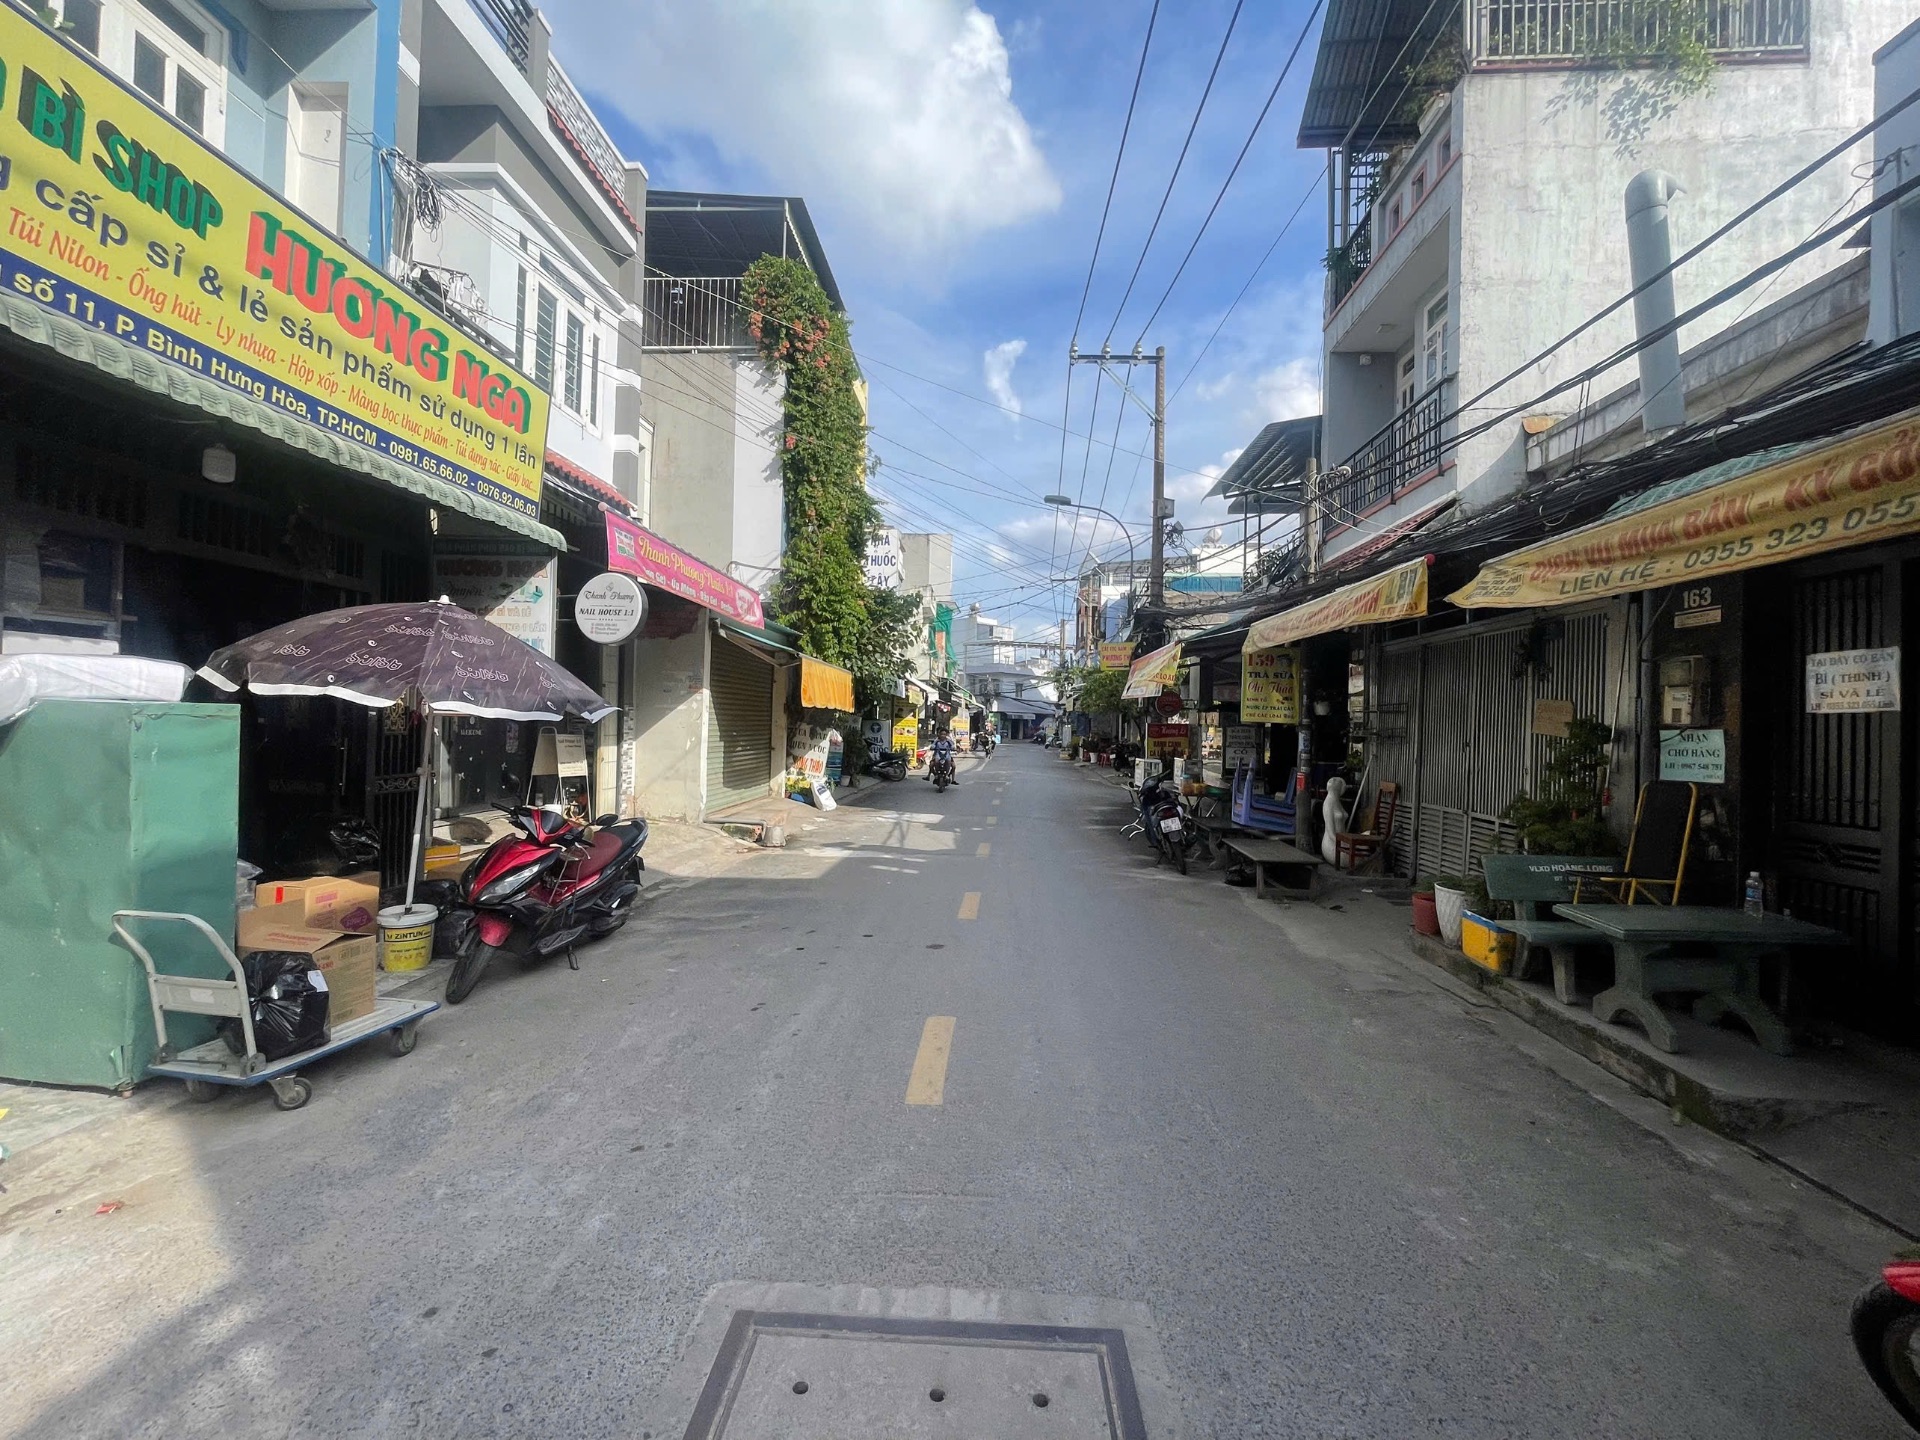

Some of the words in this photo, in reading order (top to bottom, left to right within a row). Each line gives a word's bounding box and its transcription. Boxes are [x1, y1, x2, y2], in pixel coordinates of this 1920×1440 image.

[20, 66, 86, 165] BÌ
[94, 121, 224, 240] SHOP
[245, 211, 449, 383] HƯƠNG
[453, 350, 531, 434] NGA
[36, 178, 129, 248] cấp
[146, 241, 186, 278] sỉ
[199, 265, 224, 301] &
[240, 284, 269, 323] lẻ
[279, 316, 333, 360] sản
[343, 350, 412, 402] phẩm
[419, 394, 447, 420] sử
[450, 409, 496, 452] dụng
[502, 436, 509, 454] 1
[514, 441, 536, 469] lần
[8, 206, 45, 248] Túi
[48, 230, 110, 281] Nilon
[129, 267, 168, 313] Ống
[171, 294, 201, 327] hút
[216, 316, 236, 345] Ly
[238, 333, 277, 363] nhựa
[288, 353, 315, 385] Hộp
[317, 371, 339, 397] xốp
[348, 385, 382, 419] Màng
[381, 401, 400, 425] bọc
[401, 413, 422, 437] thực
[423, 425, 449, 449] phẩm
[455, 439, 468, 458] Túi
[468, 447, 488, 471] đựng
[14, 272, 57, 303] số
[65, 292, 106, 330] 11,
[116, 314, 138, 342] P.
[147, 328, 203, 370] Bình
[210, 357, 266, 401] Hưng
[271, 386, 311, 420] Hòa,
[317, 406, 377, 447] TP.HCM
[389, 441, 469, 487] 0981.65.66.02
[477, 480, 536, 517] 0976.92.06.03
[1530, 550, 1580, 583] DỊCH
[1584, 539, 1614, 568] VỤ
[1618, 517, 1677, 560] MUA
[1682, 491, 1752, 541] BÁN
[1783, 458, 1838, 512] KÝ
[1559, 566, 1613, 595] LIÊN
[1619, 558, 1658, 583] HỆ
[1684, 535, 1754, 569] 0355
[1765, 516, 1829, 551] 323
[1843, 491, 1920, 531] 055
[1682, 586, 1712, 609] 163
[579, 607, 596, 616] NAIL
[598, 608, 622, 616] HOUSE
[623, 609, 634, 617] 1:1
[1248, 653, 1275, 667] 159
[1247, 668, 1269, 679] TRÀ
[1273, 670, 1295, 680] SỮA
[1680, 733, 1708, 745] NHẬN
[1691, 746, 1720, 758] HÀNG
[1551, 863, 1583, 872] HOÀNG
